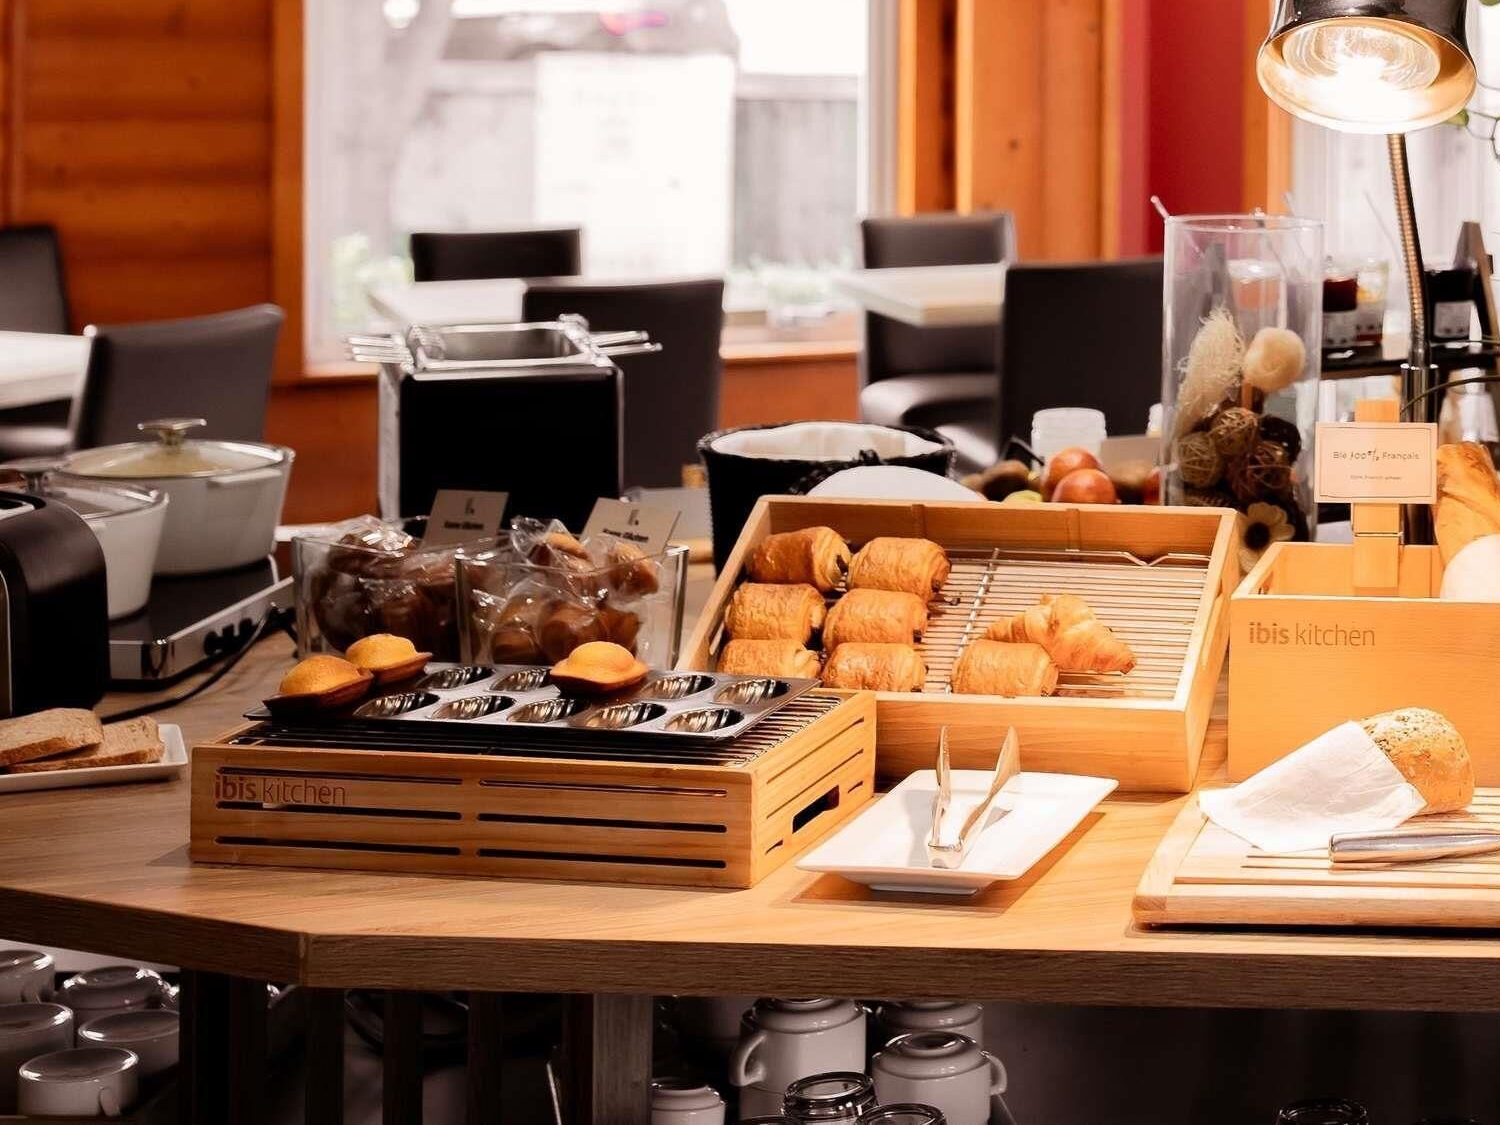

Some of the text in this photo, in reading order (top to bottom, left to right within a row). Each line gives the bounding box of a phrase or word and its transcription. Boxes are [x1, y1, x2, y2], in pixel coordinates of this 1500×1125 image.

[1248, 621, 1376, 647] ibis kitchen
[214, 775, 346, 805] ibis kitchen
